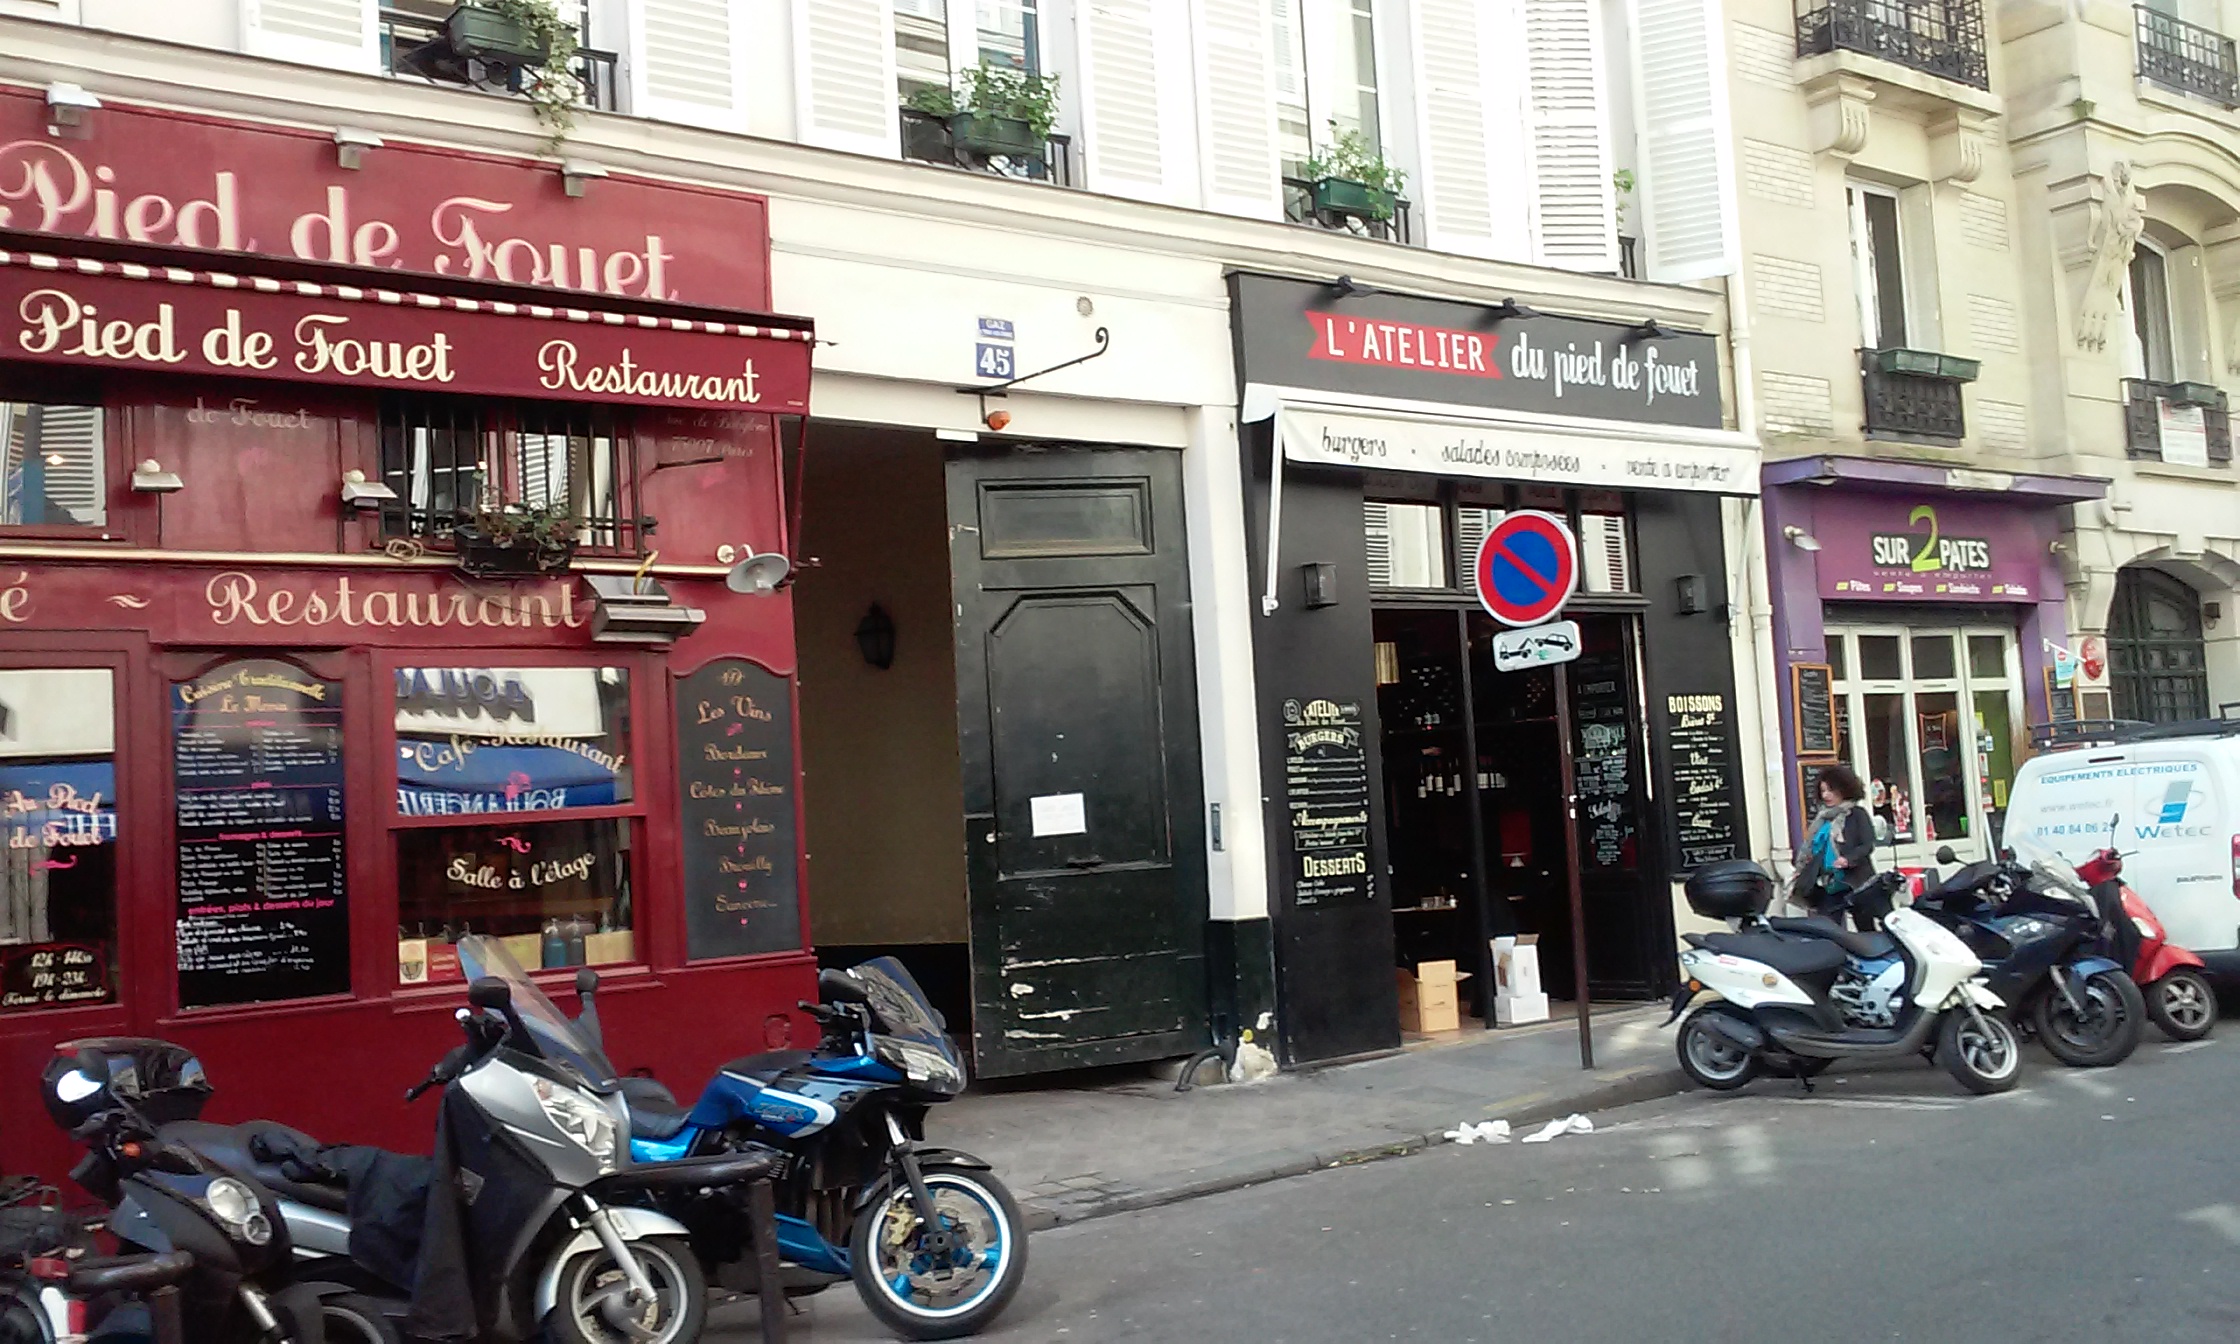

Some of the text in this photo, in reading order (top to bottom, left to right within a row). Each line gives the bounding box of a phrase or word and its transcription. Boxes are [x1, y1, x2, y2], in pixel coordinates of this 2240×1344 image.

[0, 139, 680, 300] Pied de Fouet
[19, 289, 455, 382] Pied de Fouet
[537, 339, 761, 404] Restaurant
[980, 347, 1010, 375] 45
[1326, 318, 1700, 406] L'ATELIER du pied de fouet
[1322, 427, 1387, 463] burgers
[1441, 439, 1500, 466] salades
[1873, 537, 1910, 564] SUR
[1909, 504, 1942, 573] 2
[206, 571, 584, 628] Restaurant
[1668, 695, 1722, 713] BOISSONS
[1298, 730, 1345, 751] BURGERS
[2041, 763, 2199, 785] EQUIPEMENTS ELECTRIQUES
[2135, 825, 2213, 839] Wetec
[447, 858, 503, 889] Salle
[508, 869, 525, 889] à
[1303, 852, 1366, 878] DESSERTS
